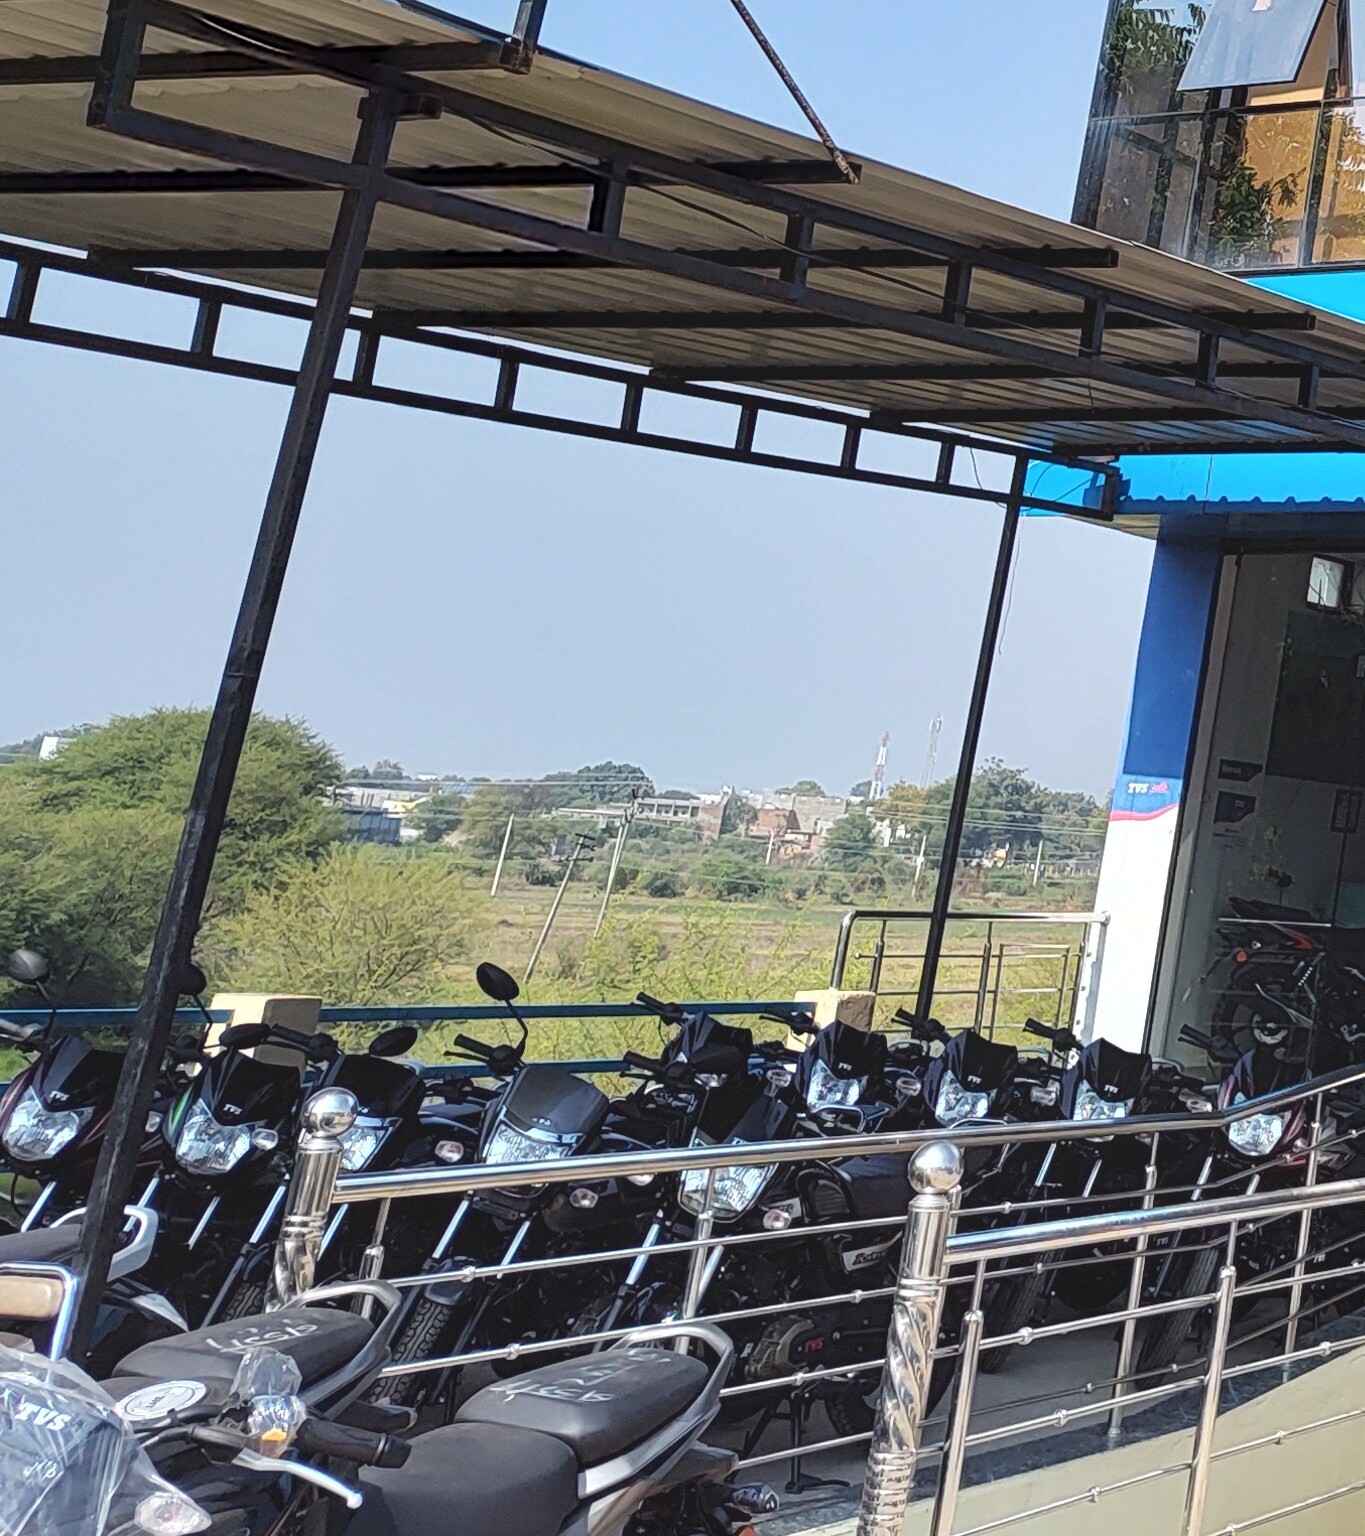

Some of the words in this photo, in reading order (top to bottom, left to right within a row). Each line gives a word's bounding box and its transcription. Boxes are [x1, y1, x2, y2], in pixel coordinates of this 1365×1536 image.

[1127, 782, 1150, 794] TVS
[50, 1090, 69, 1101] TVS
[222, 1103, 243, 1115] TVS
[15, 1402, 72, 1431] TVS
